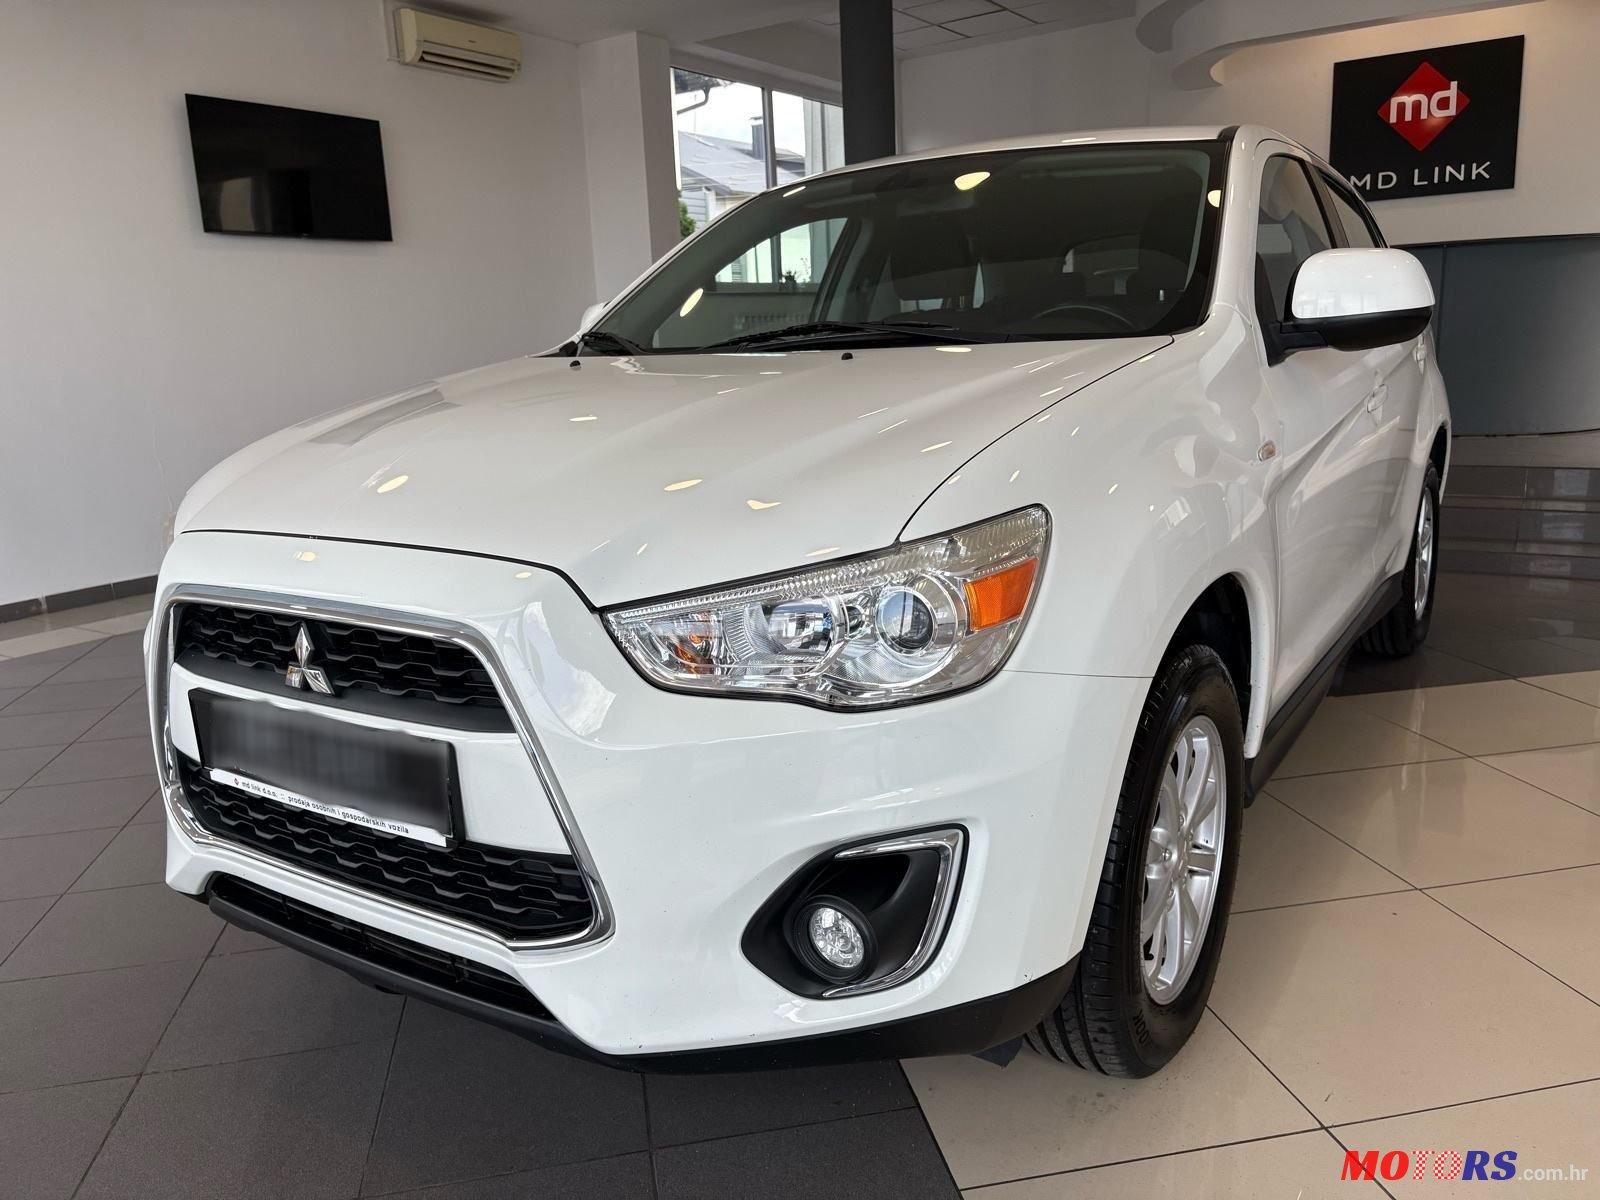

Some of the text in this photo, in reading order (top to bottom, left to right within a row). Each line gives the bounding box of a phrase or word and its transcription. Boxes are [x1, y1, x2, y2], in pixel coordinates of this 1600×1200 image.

[1389, 80, 1458, 124] md
[1349, 161, 1491, 191] MD LINK
[287, 796, 311, 808] prodaja
[311, 802, 338, 815] osobnih
[341, 811, 387, 829] gospodarskih
[387, 822, 409, 834] vozila
